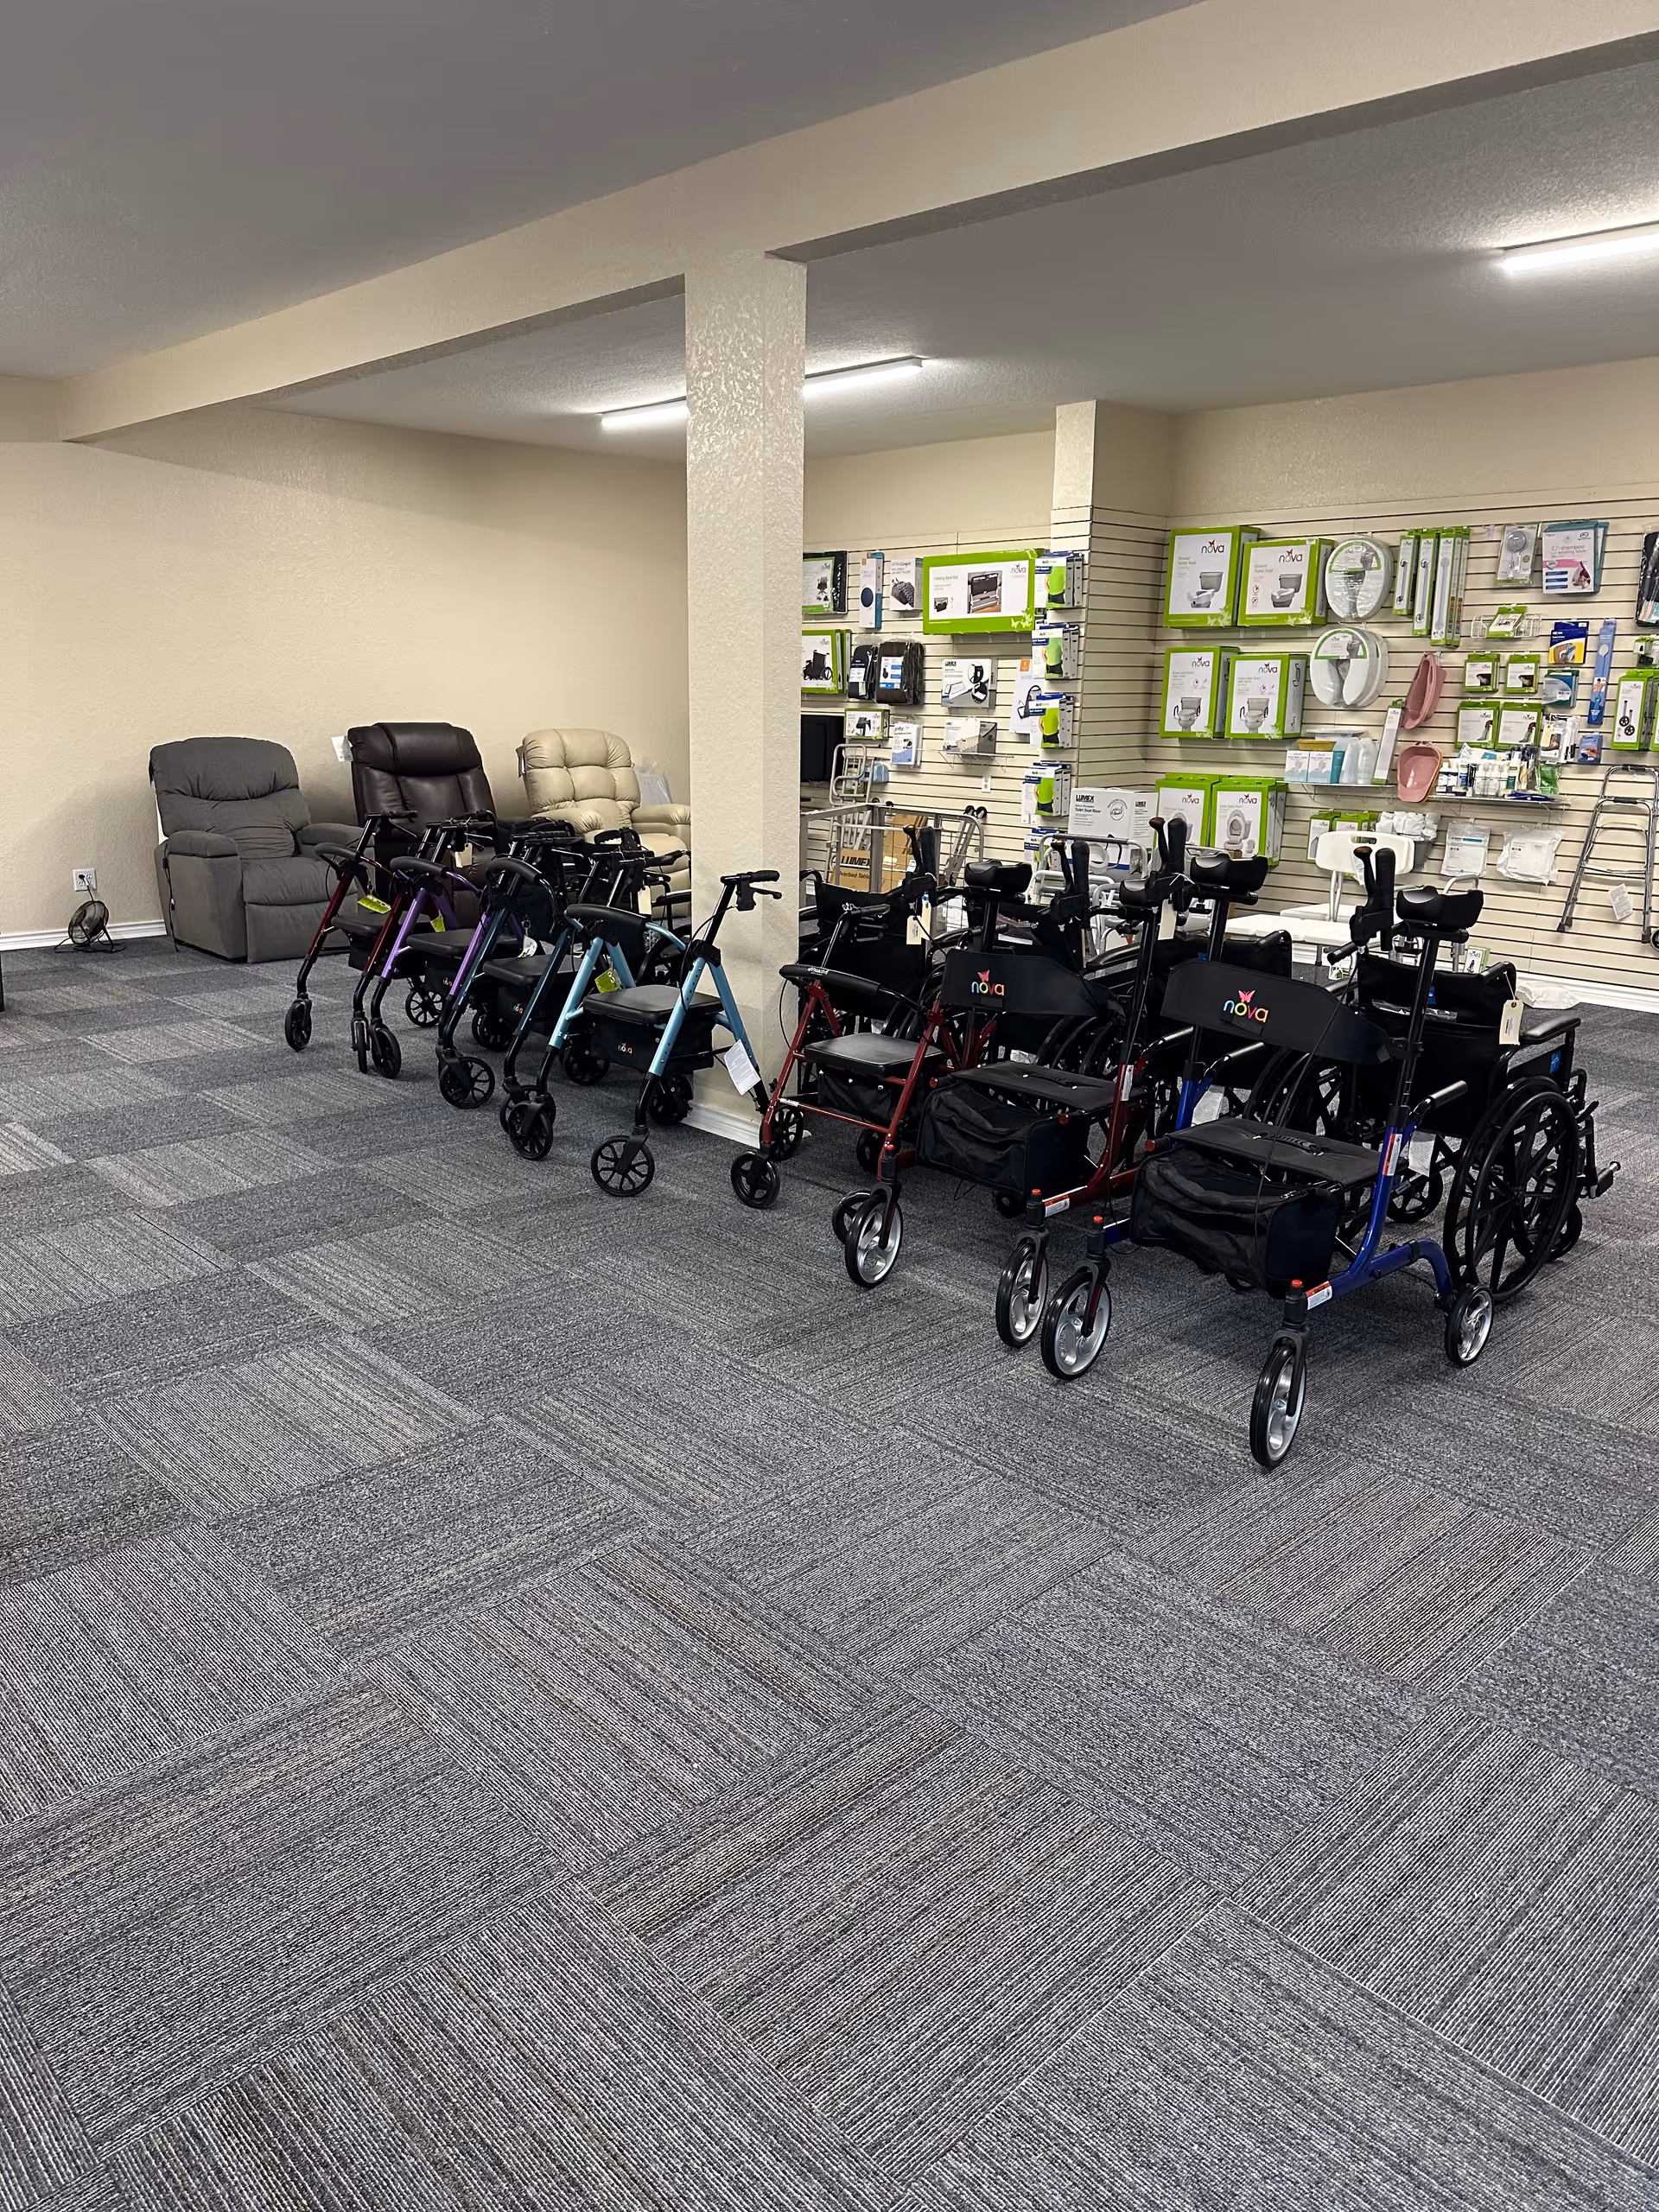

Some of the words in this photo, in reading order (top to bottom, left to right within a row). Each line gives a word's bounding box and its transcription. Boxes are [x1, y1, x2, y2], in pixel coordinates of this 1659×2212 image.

[1201, 544, 1225, 553] nova
[971, 981, 1004, 996] nova
[1224, 999, 1269, 1023] nova
[618, 1045, 632, 1054] nova
